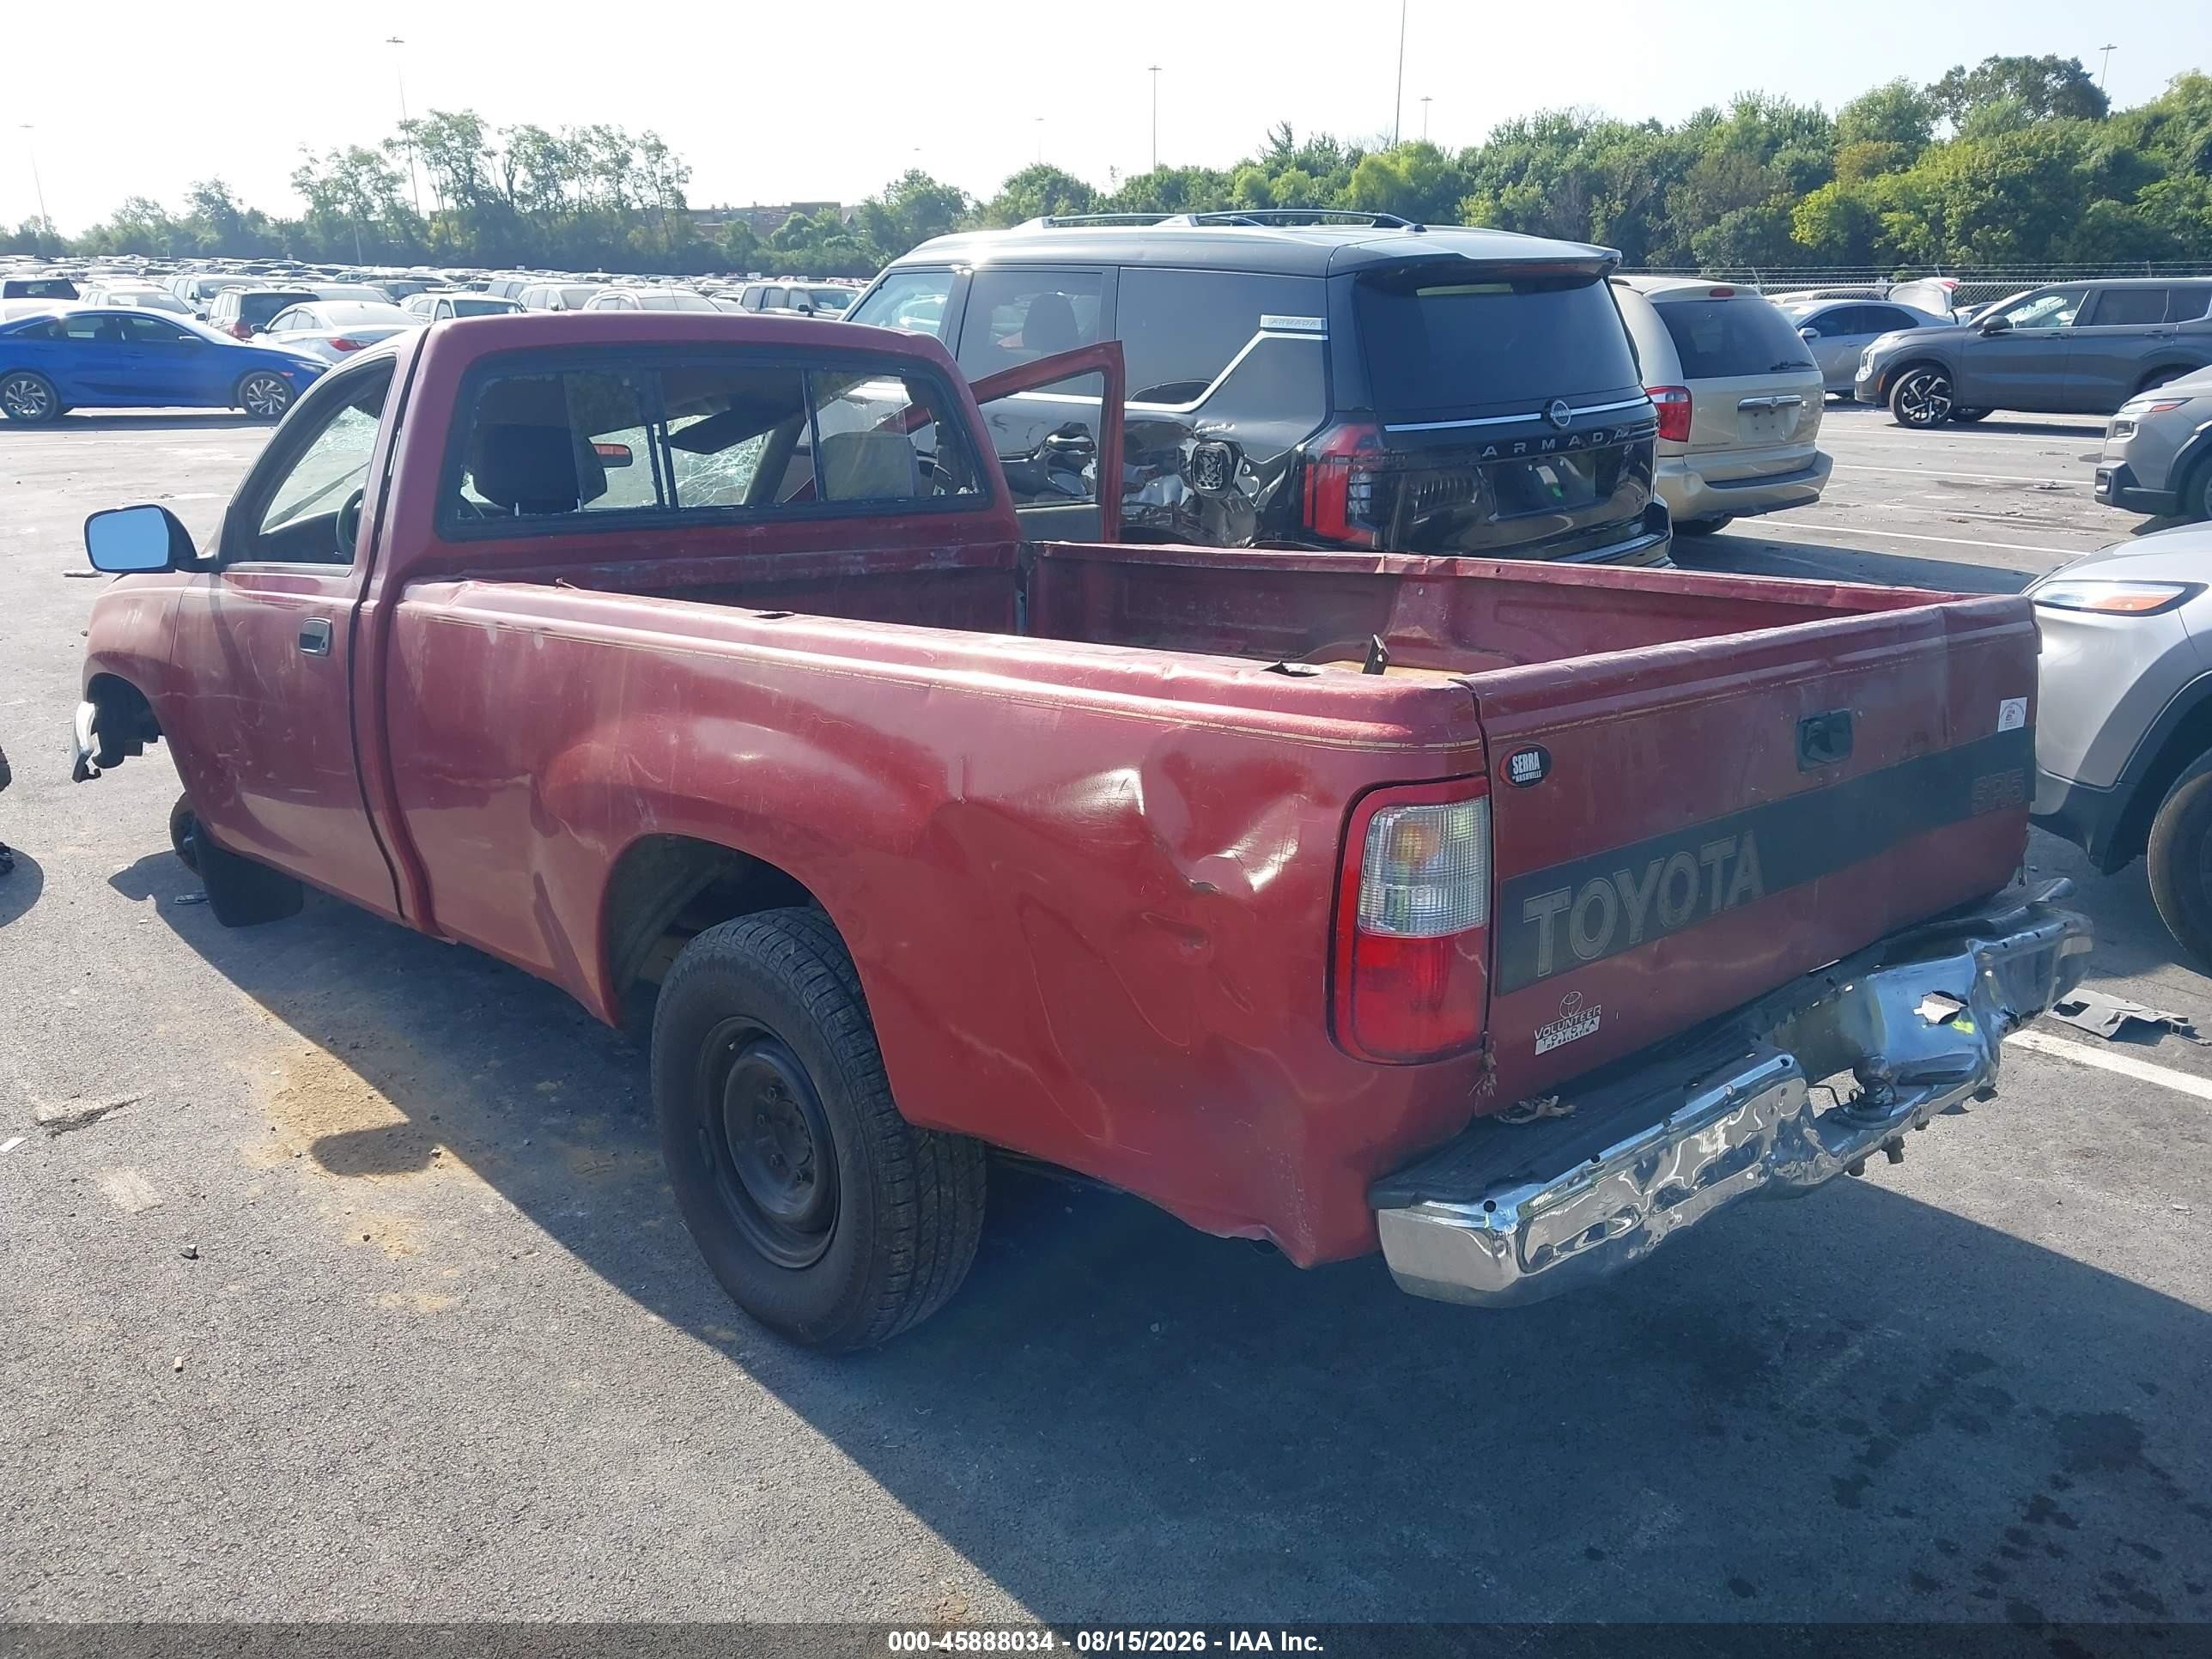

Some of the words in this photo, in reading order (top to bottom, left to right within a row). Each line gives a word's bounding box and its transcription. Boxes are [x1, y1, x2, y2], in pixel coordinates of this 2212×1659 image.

[1481, 428, 1629, 457] ARMADA
[1512, 751, 1540, 775] SERRA
[1523, 830, 1765, 977] TOYOTA
[1534, 1005, 1601, 1040] VOLUNTEER
[1542, 1019, 1595, 1045] TOYOTA
